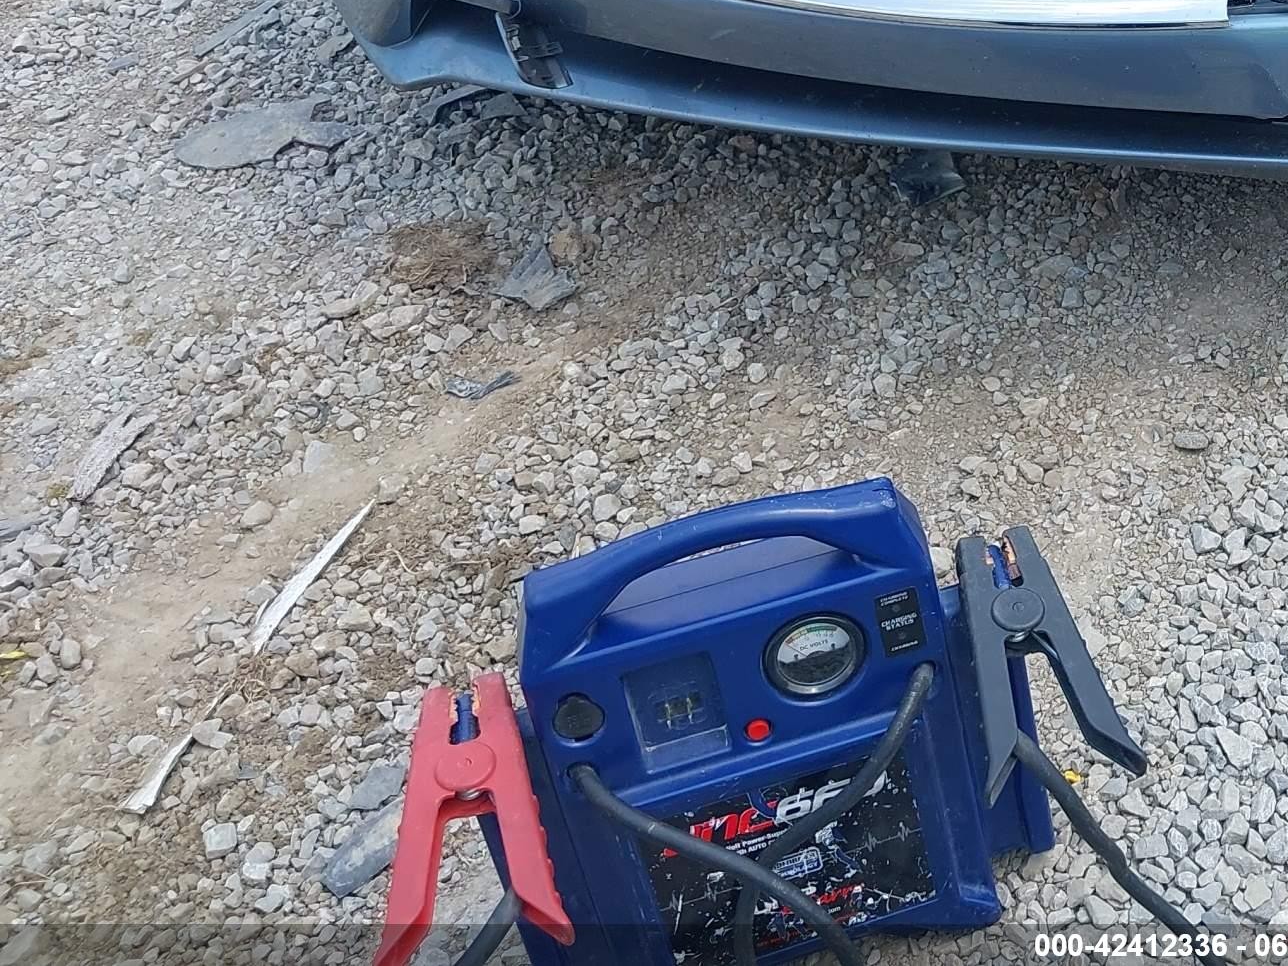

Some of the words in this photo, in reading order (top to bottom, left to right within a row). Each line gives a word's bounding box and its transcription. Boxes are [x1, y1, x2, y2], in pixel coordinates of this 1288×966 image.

[881, 612, 918, 628] CHARGING
[886, 619, 914, 631] STATUS
[748, 843, 767, 854] AUTO
